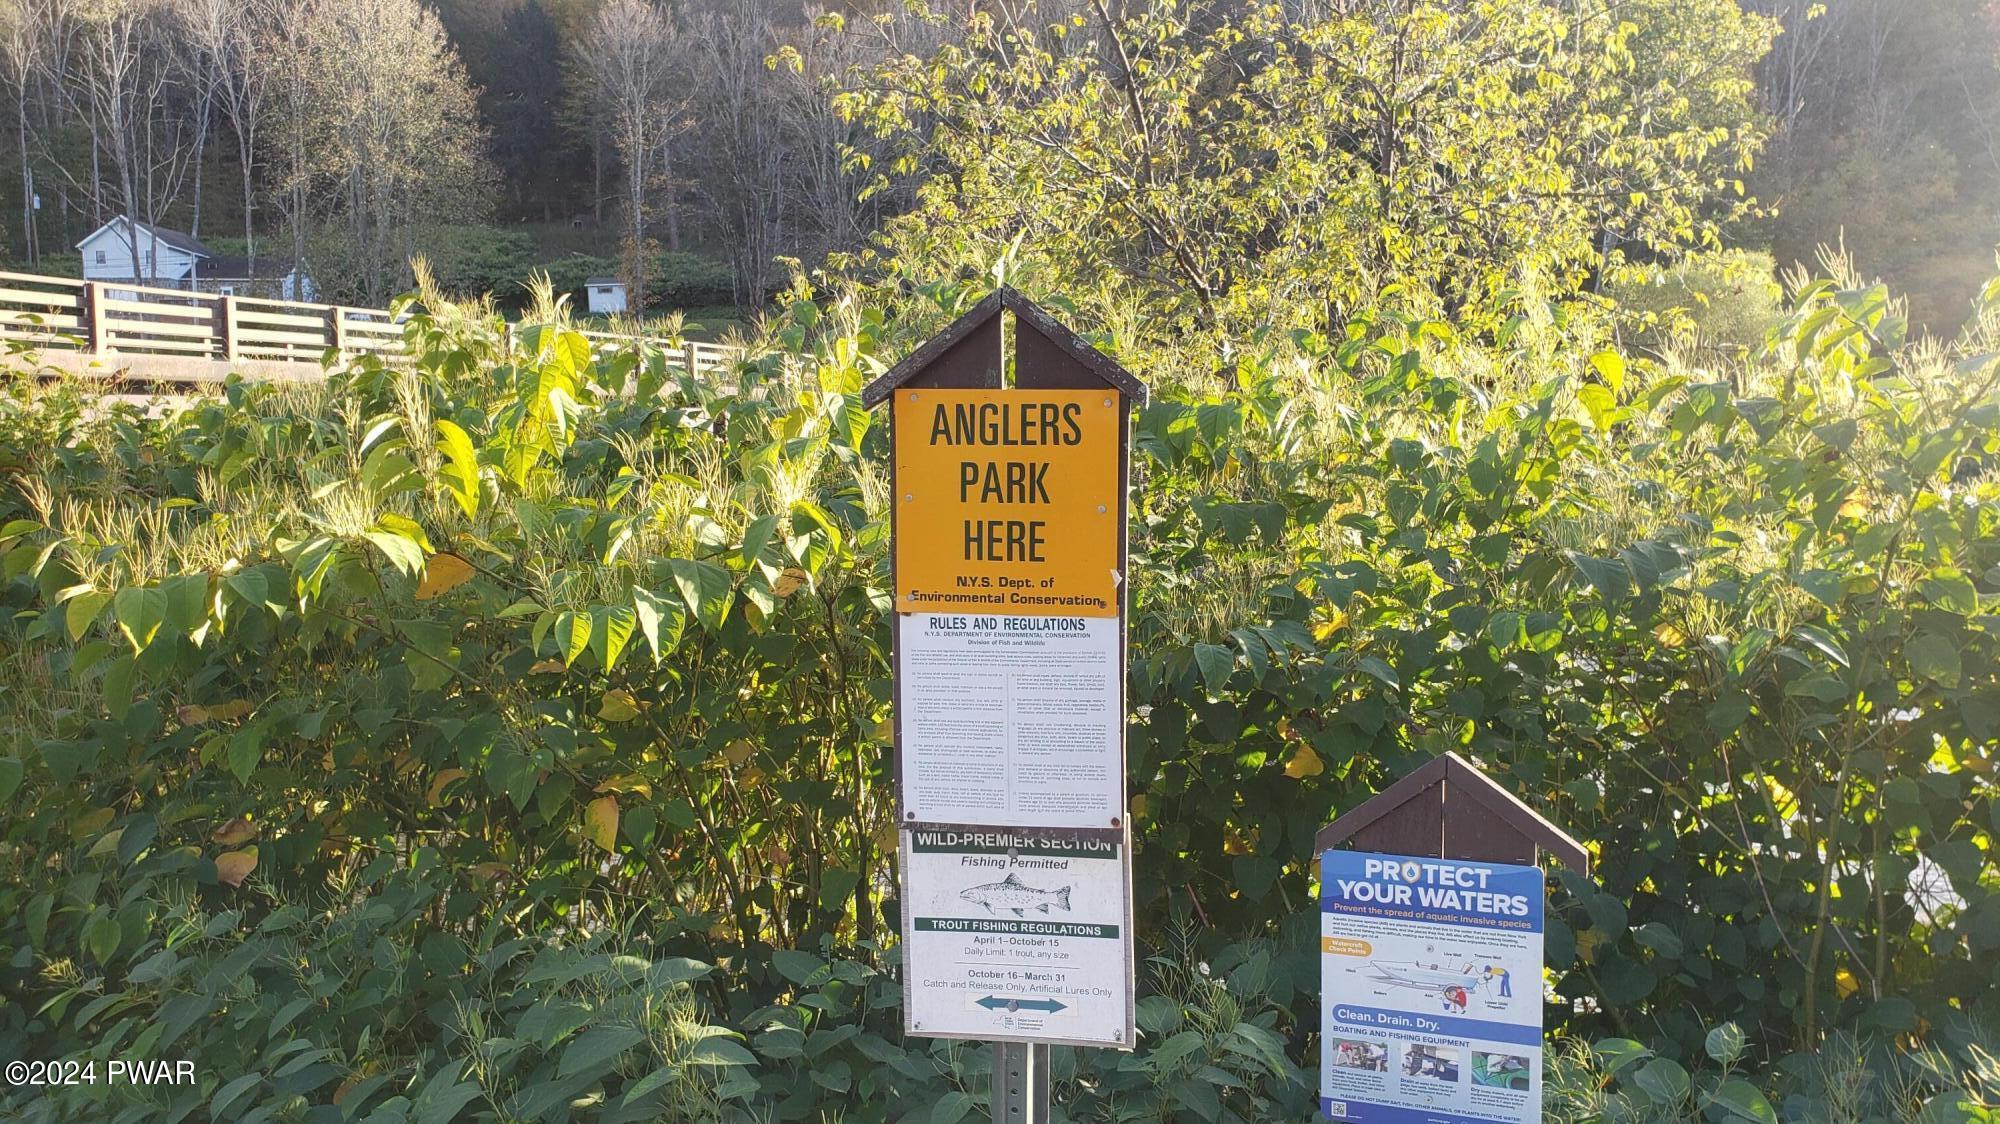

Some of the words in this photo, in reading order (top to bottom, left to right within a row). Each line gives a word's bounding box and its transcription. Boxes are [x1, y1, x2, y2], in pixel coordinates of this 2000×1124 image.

[930, 403, 1082, 446] ANGLERS
[960, 462, 1050, 504] PARK
[964, 520, 1046, 562] HERE
[957, 576, 993, 587] N.Y.S.
[999, 577, 1034, 589] Dept.
[1040, 577, 1054, 588] of
[912, 590, 1004, 603] Environmental
[1010, 593, 1100, 606] Conservation
[930, 617, 966, 630] RULES
[973, 618, 997, 630] AND
[1004, 618, 1085, 631] REGULATIONS
[918, 832, 1035, 848] WILD-PREMIER
[1041, 838, 1111, 851] SECTION
[961, 856, 1005, 869] Fishing
[1010, 857, 1068, 870] Permitted
[1366, 859, 1492, 889] PROTECT
[1337, 880, 1411, 906] YOUR
[1417, 886, 1529, 916] WATERS
[1334, 903, 1367, 914] Prevent
[1368, 906, 1382, 915] the
[1384, 908, 1413, 920] spread
[1415, 910, 1424, 918] of
[1426, 912, 1457, 922] aquatic
[1460, 915, 1495, 926] invasive
[1498, 919, 1531, 929] species
[932, 920, 969, 930] TROUT
[973, 922, 1017, 932] FISHING
[1021, 924, 1101, 936] REGULATIONS
[974, 936, 996, 945] April
[964, 948, 983, 957] Daily
[985, 948, 1006, 957] Limit:
[1015, 950, 1035, 959] trout,
[1037, 952, 1051, 960] any
[968, 970, 1004, 979] October
[924, 980, 948, 988] Catch
[951, 980, 966, 989] and
[969, 981, 1003, 990] Release
[1006, 983, 1027, 992] Only,
[1030, 984, 1062, 993] Artificial
[1066, 986, 1089, 995] Lures
[1092, 987, 1112, 997] Only
[1338, 1008, 1374, 1023] Clean.
[1378, 1013, 1413, 1027] Drain.
[1416, 1018, 1440, 1031] Dry.
[1333, 1026, 1368, 1036] BOATING
[1369, 1029, 1386, 1038] AND
[1389, 1031, 1421, 1042] FISHING
[1422, 1035, 1470, 1048] EQUIPMENT
